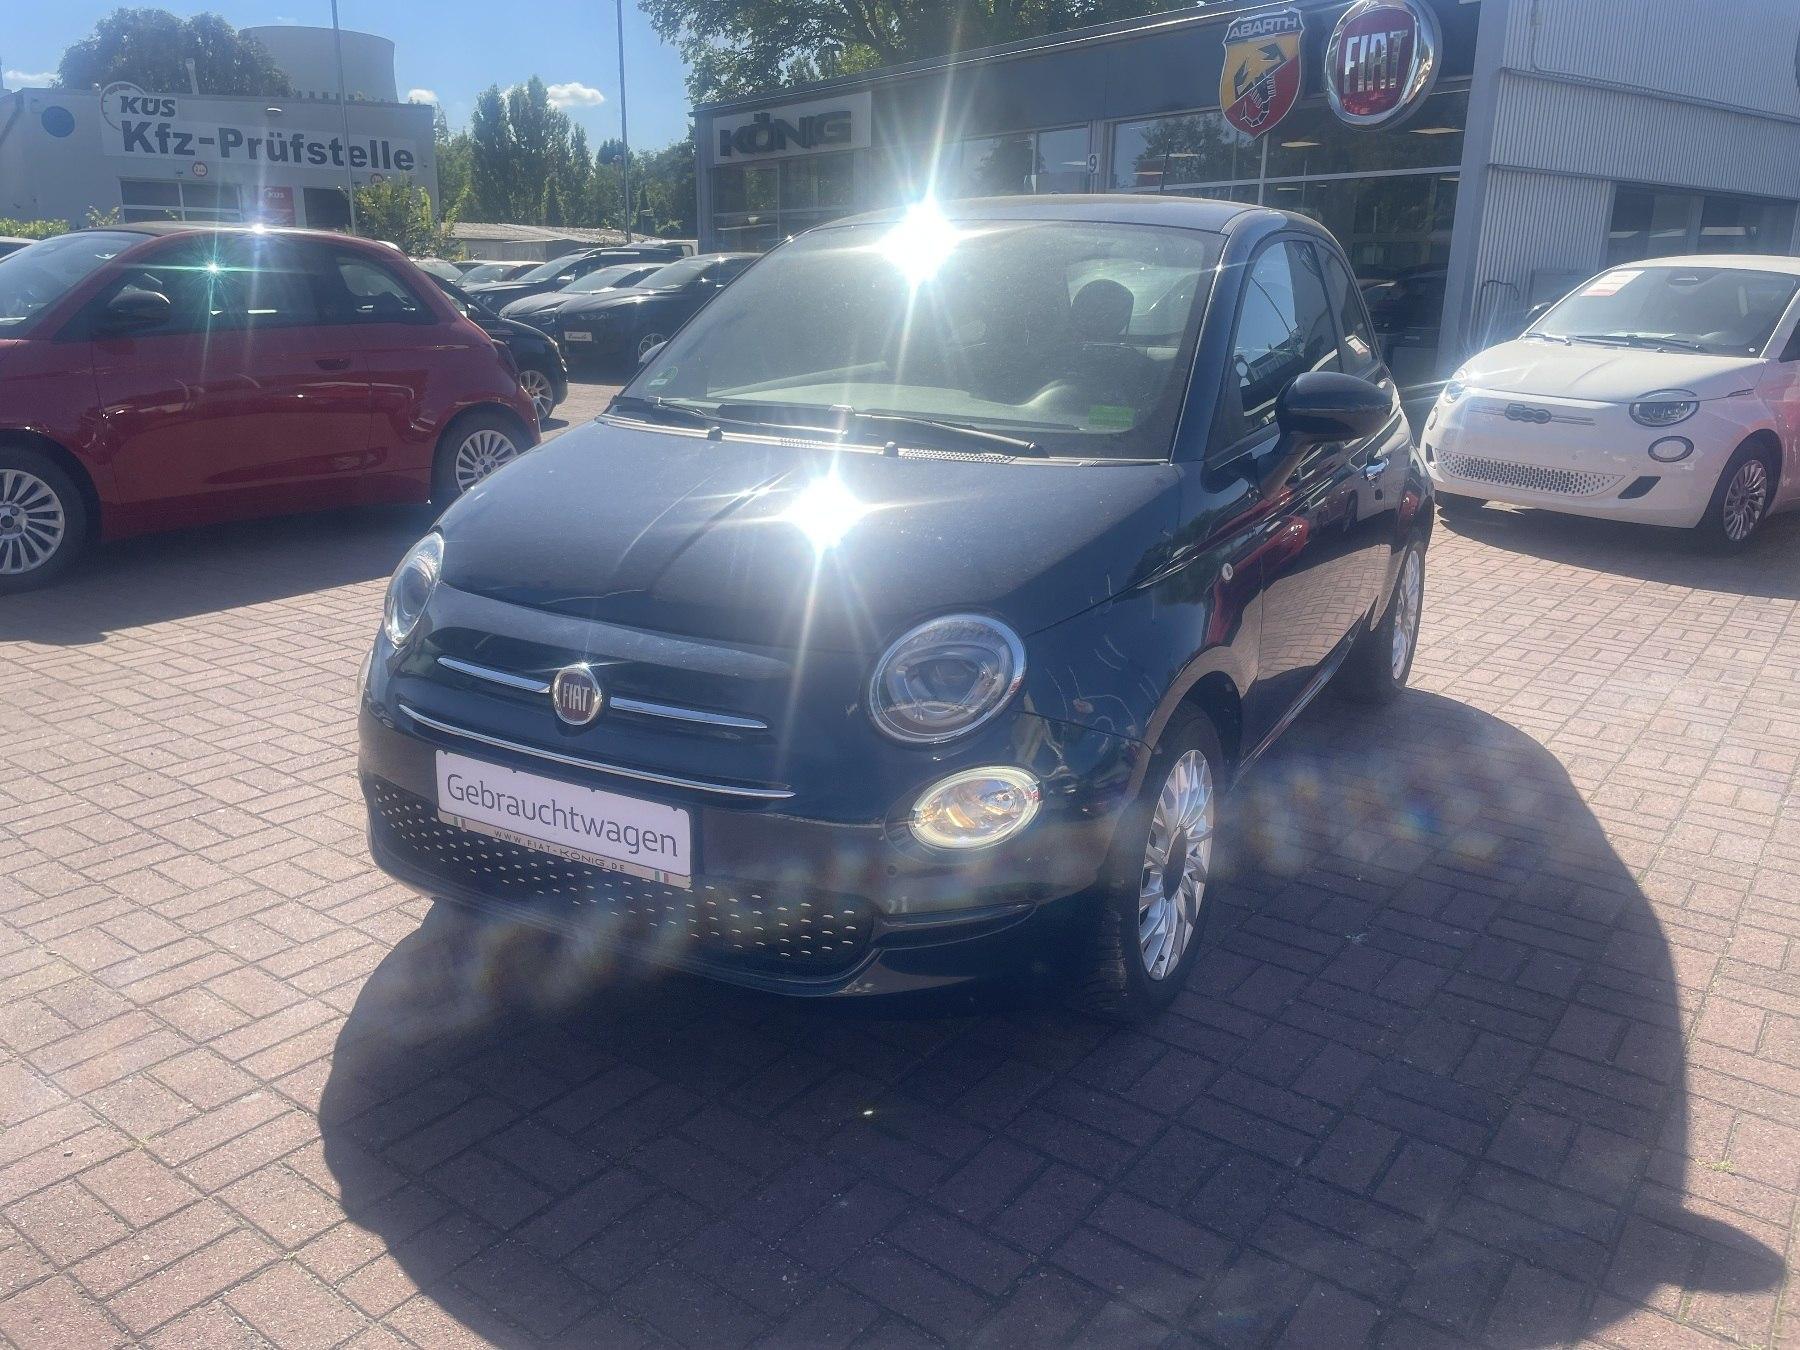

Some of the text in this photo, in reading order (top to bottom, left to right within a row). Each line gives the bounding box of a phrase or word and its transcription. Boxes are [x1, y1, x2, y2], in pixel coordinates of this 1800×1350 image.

[1228, 17, 1298, 39] ABARTH
[1343, 29, 1409, 94] FIAT
[120, 95, 176, 118] KÜS
[121, 120, 415, 171] Kfz-Prüfstelle
[719, 111, 852, 157] KÖNIG
[562, 682, 591, 712] FIAT
[446, 773, 678, 857] Gebrauchtwagen
[494, 829, 626, 872] WWW.FIAT-KÖNIG.DE
